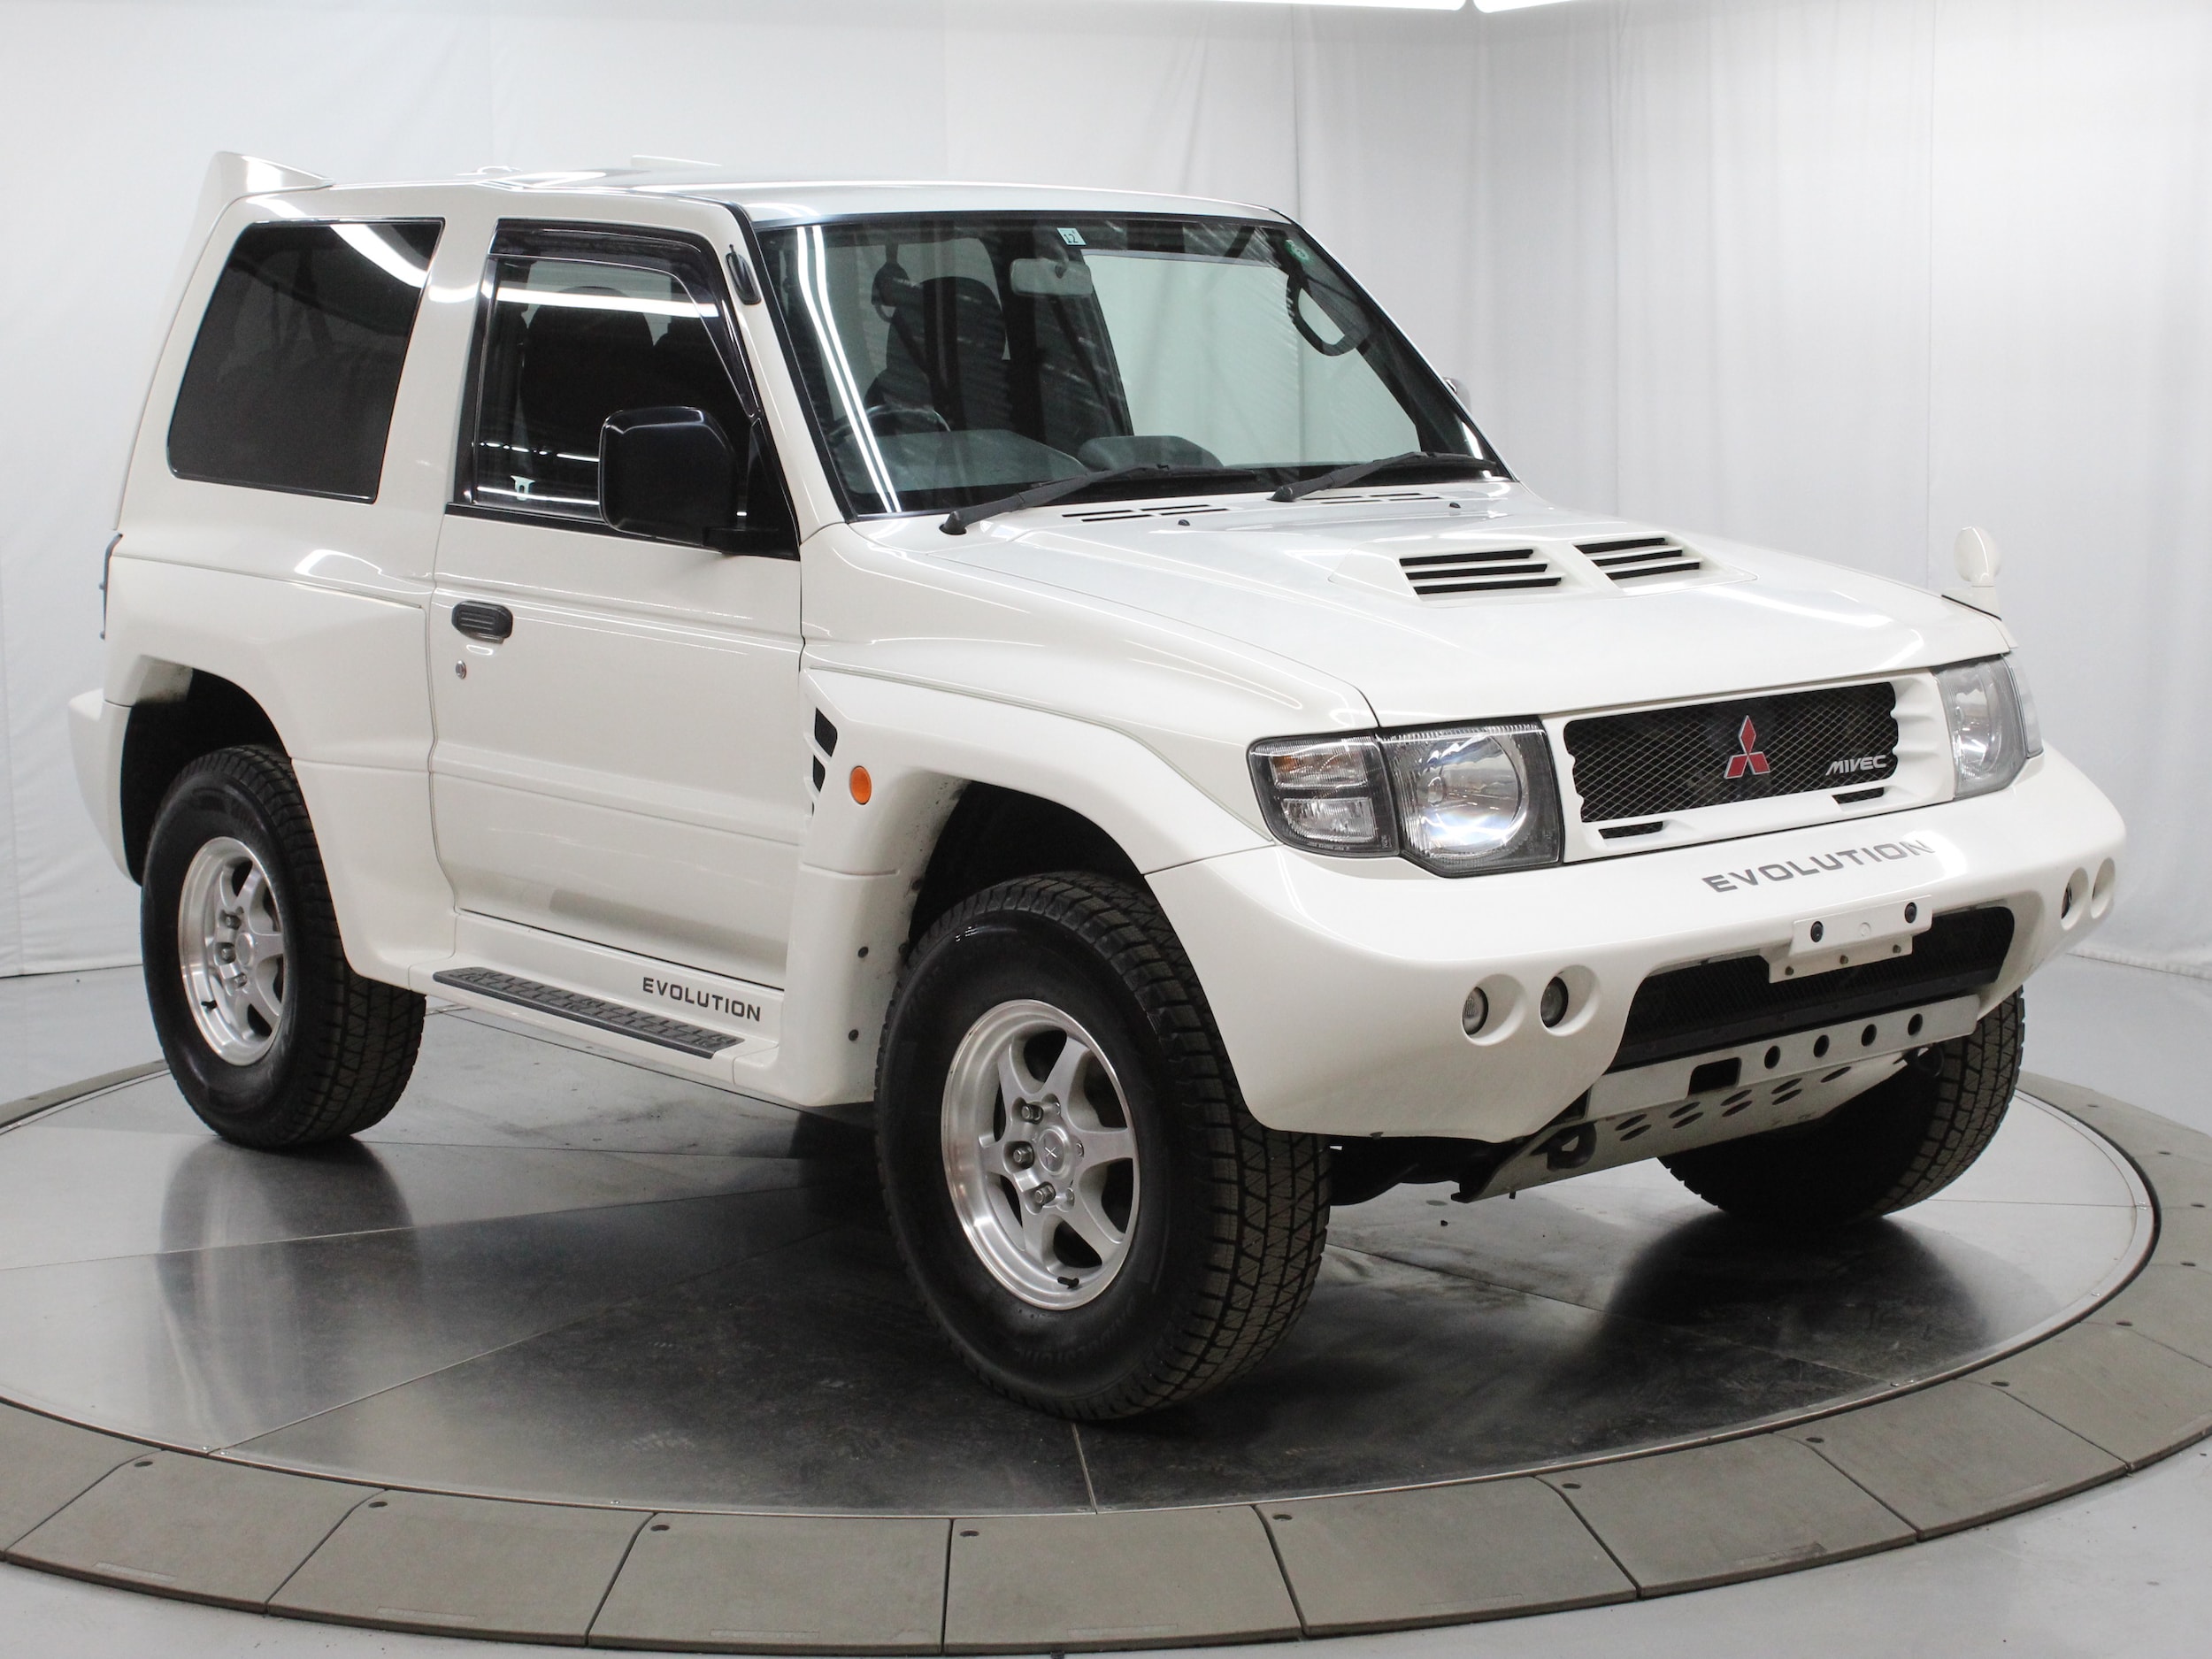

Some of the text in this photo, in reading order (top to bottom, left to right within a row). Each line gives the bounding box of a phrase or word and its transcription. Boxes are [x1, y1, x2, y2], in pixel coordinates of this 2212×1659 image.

[1825, 754, 1887, 776] MIVEC
[1701, 840, 1935, 893] EVOLUTION
[642, 977, 761, 1022] EVOLUTION
